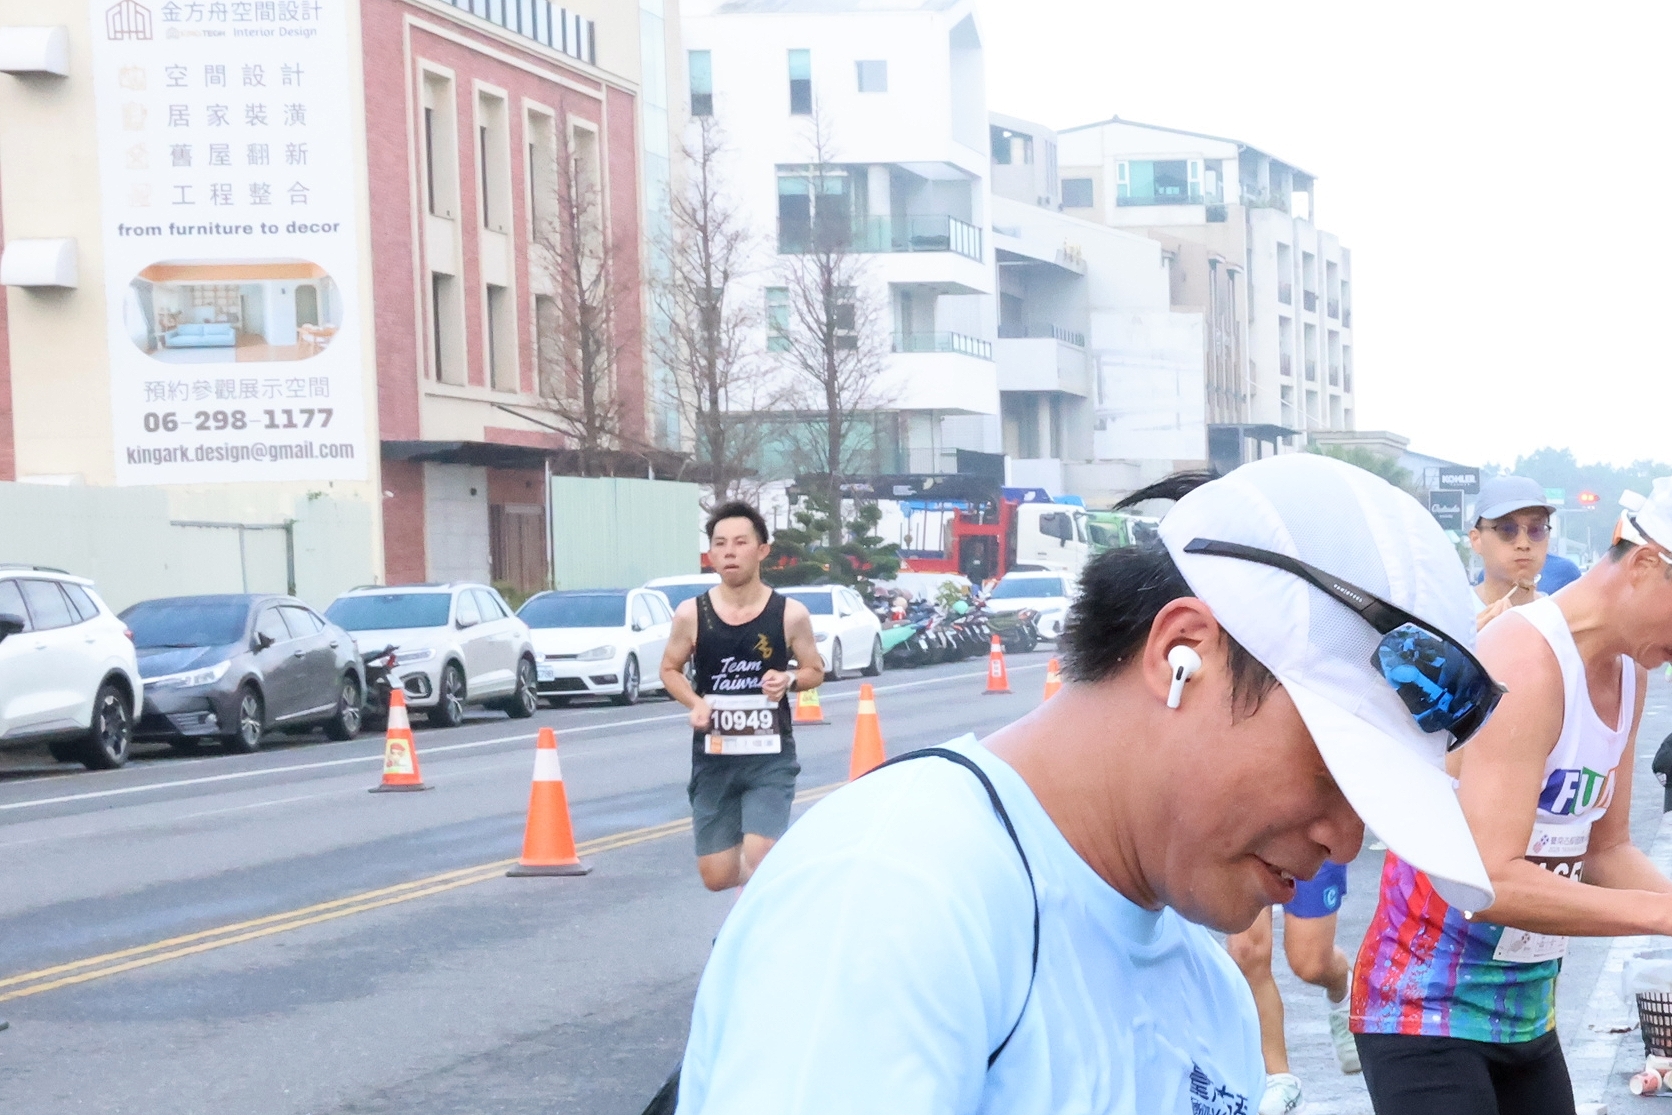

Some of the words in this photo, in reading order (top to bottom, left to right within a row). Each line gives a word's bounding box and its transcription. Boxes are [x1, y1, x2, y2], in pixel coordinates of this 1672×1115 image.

[161, 0, 323, 22] 金方舟空間設計
[233, 27, 275, 37] Interior
[279, 27, 317, 39] Design
[165, 63, 305, 88] 空間設計
[168, 103, 308, 127] 居家裝潢
[169, 142, 309, 167] 舊屋翻新
[172, 181, 310, 206] 工程整合
[118, 223, 162, 237] from
[169, 222, 253, 236] furniture
[260, 222, 279, 235] to
[286, 221, 340, 234] decor
[143, 377, 330, 403] 預約參觀展示空間
[143, 407, 334, 433] 06-298-1177
[126, 441, 355, 465] kingark.design@gmail.com
[721, 656, 762, 672] Team
[711, 674, 765, 691] Taiwa
[711, 710, 773, 731] 10949
